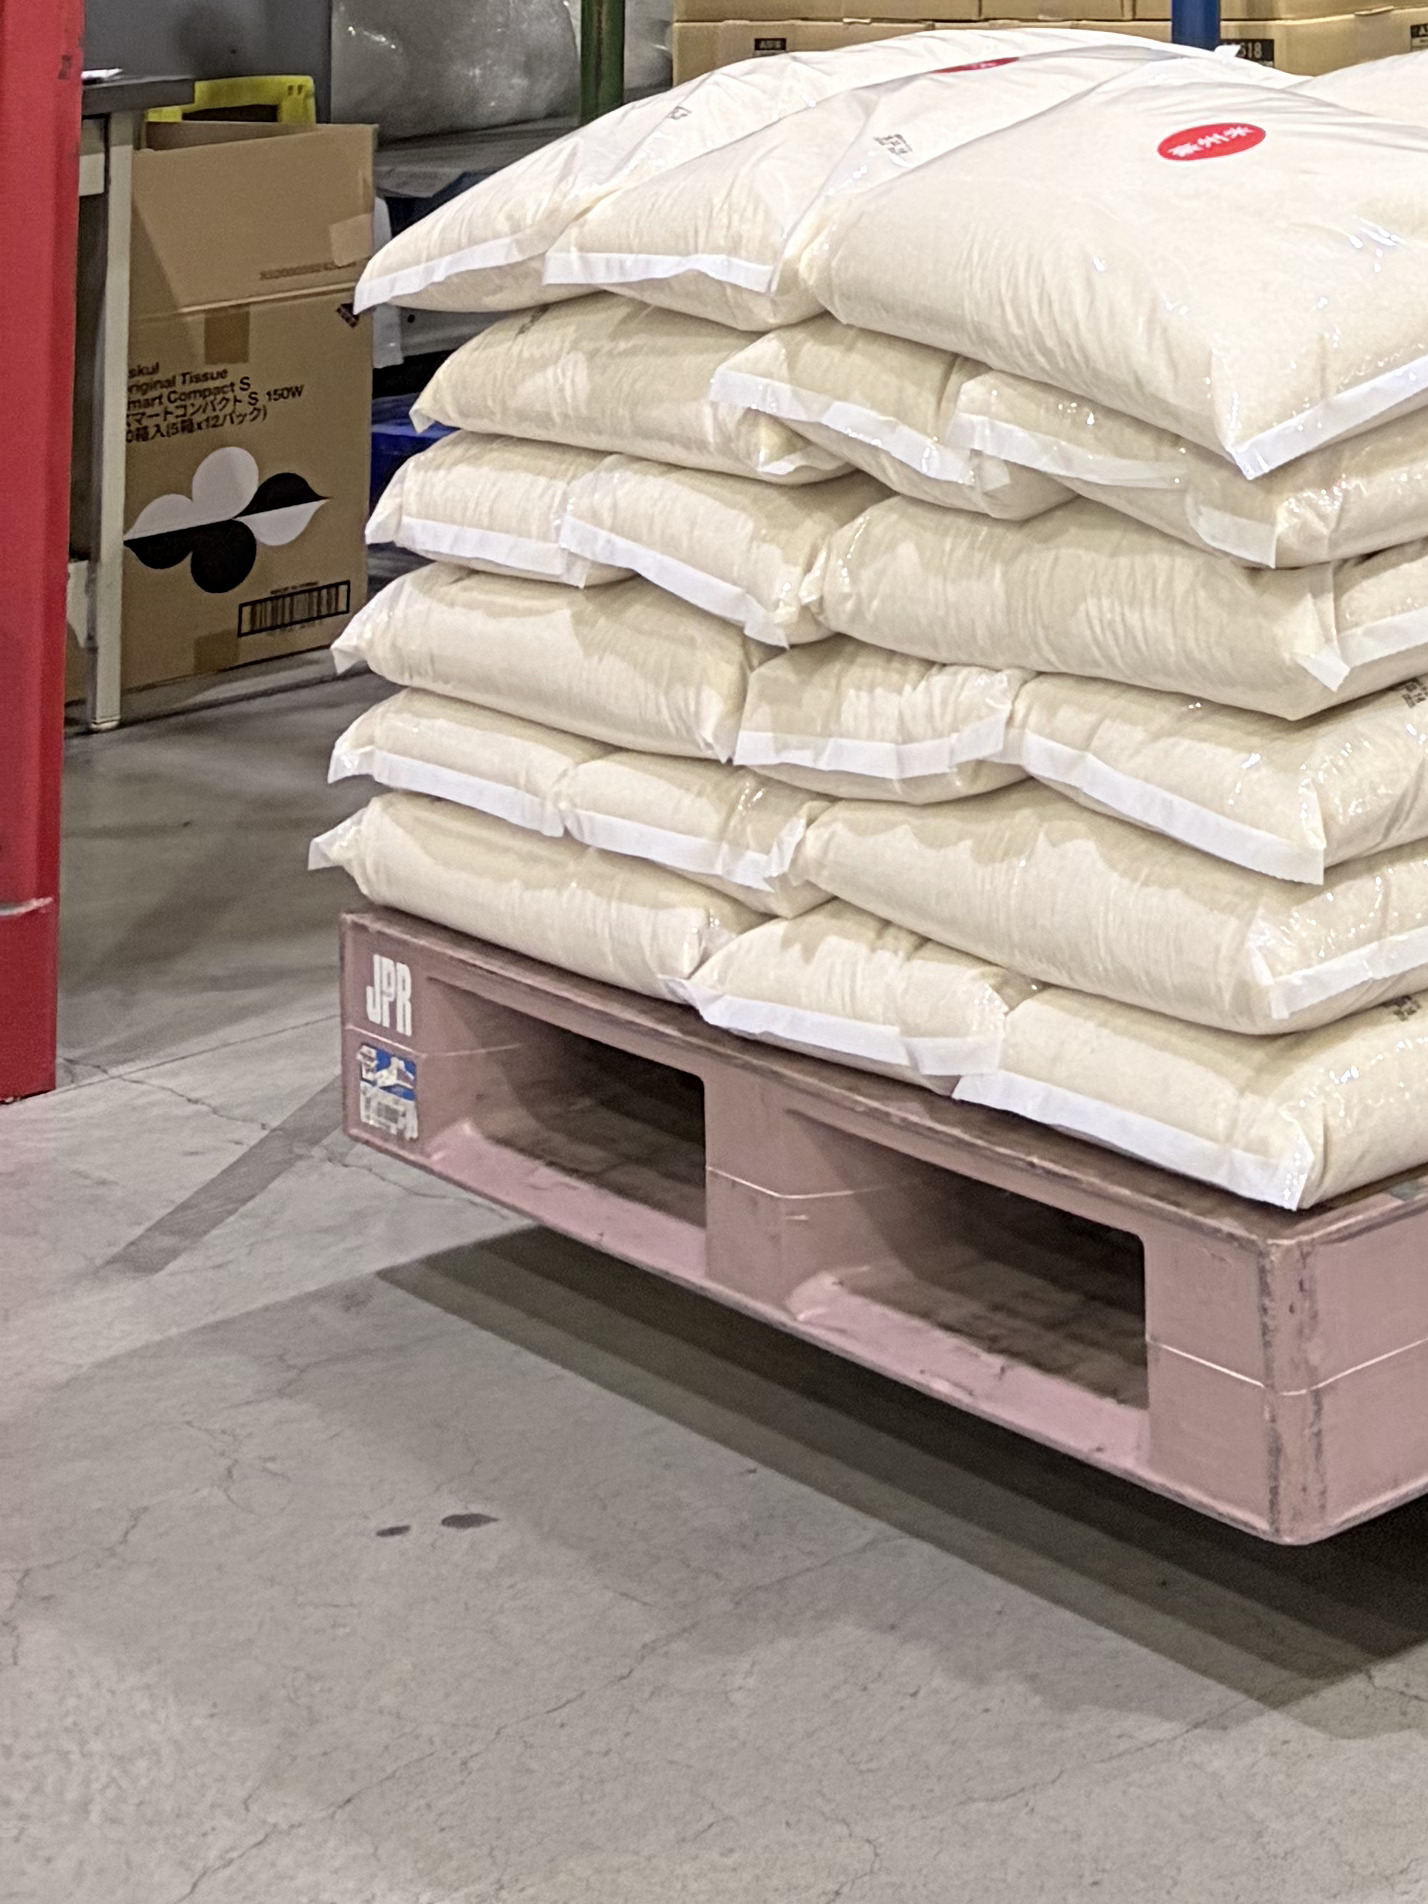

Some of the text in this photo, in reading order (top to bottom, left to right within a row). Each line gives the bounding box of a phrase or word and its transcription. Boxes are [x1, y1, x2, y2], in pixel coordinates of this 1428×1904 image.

[127, 368, 229, 394] riginal Tissue
[128, 363, 160, 379] skul
[127, 377, 251, 413] mart Compact S
[248, 391, 259, 407] S
[266, 385, 304, 402] 150W
[367, 953, 412, 1037] JPR
